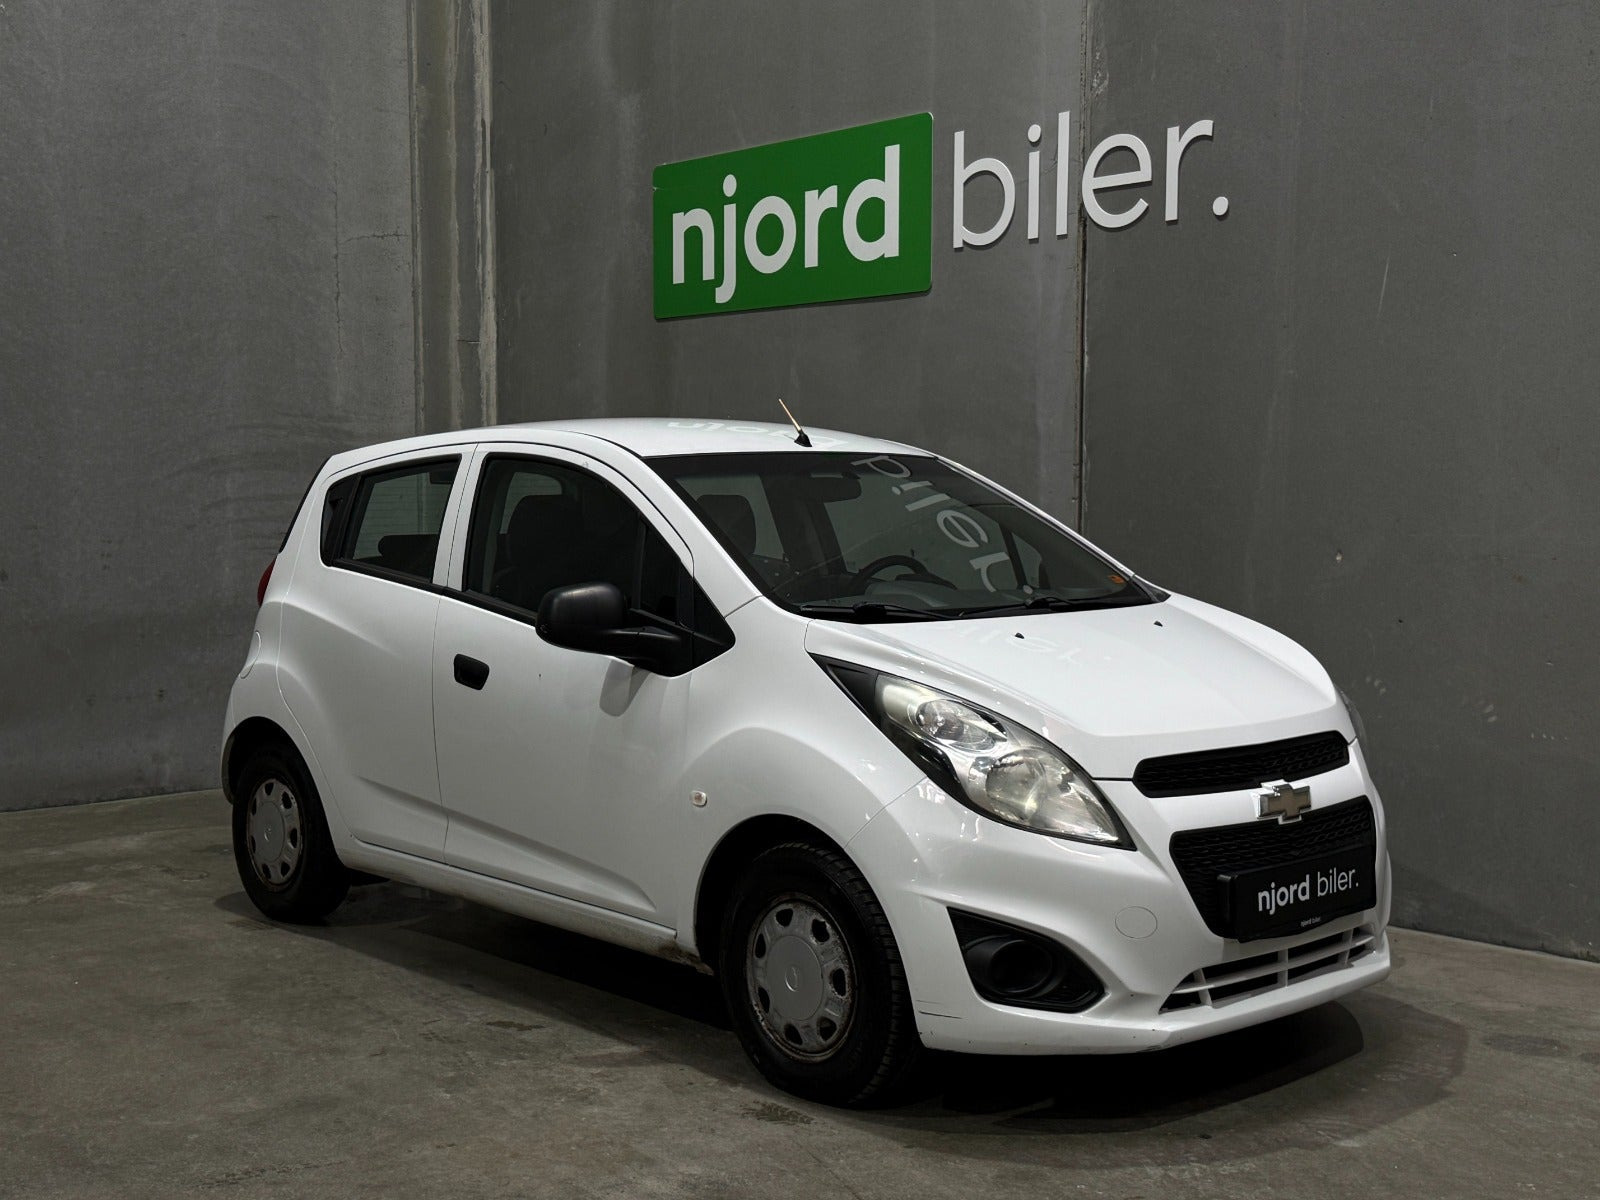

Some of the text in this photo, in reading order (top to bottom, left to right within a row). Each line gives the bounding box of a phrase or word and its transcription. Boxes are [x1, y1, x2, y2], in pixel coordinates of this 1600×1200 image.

[672, 111, 1230, 304] njord biler.
[1257, 867, 1359, 915] njord biler.
